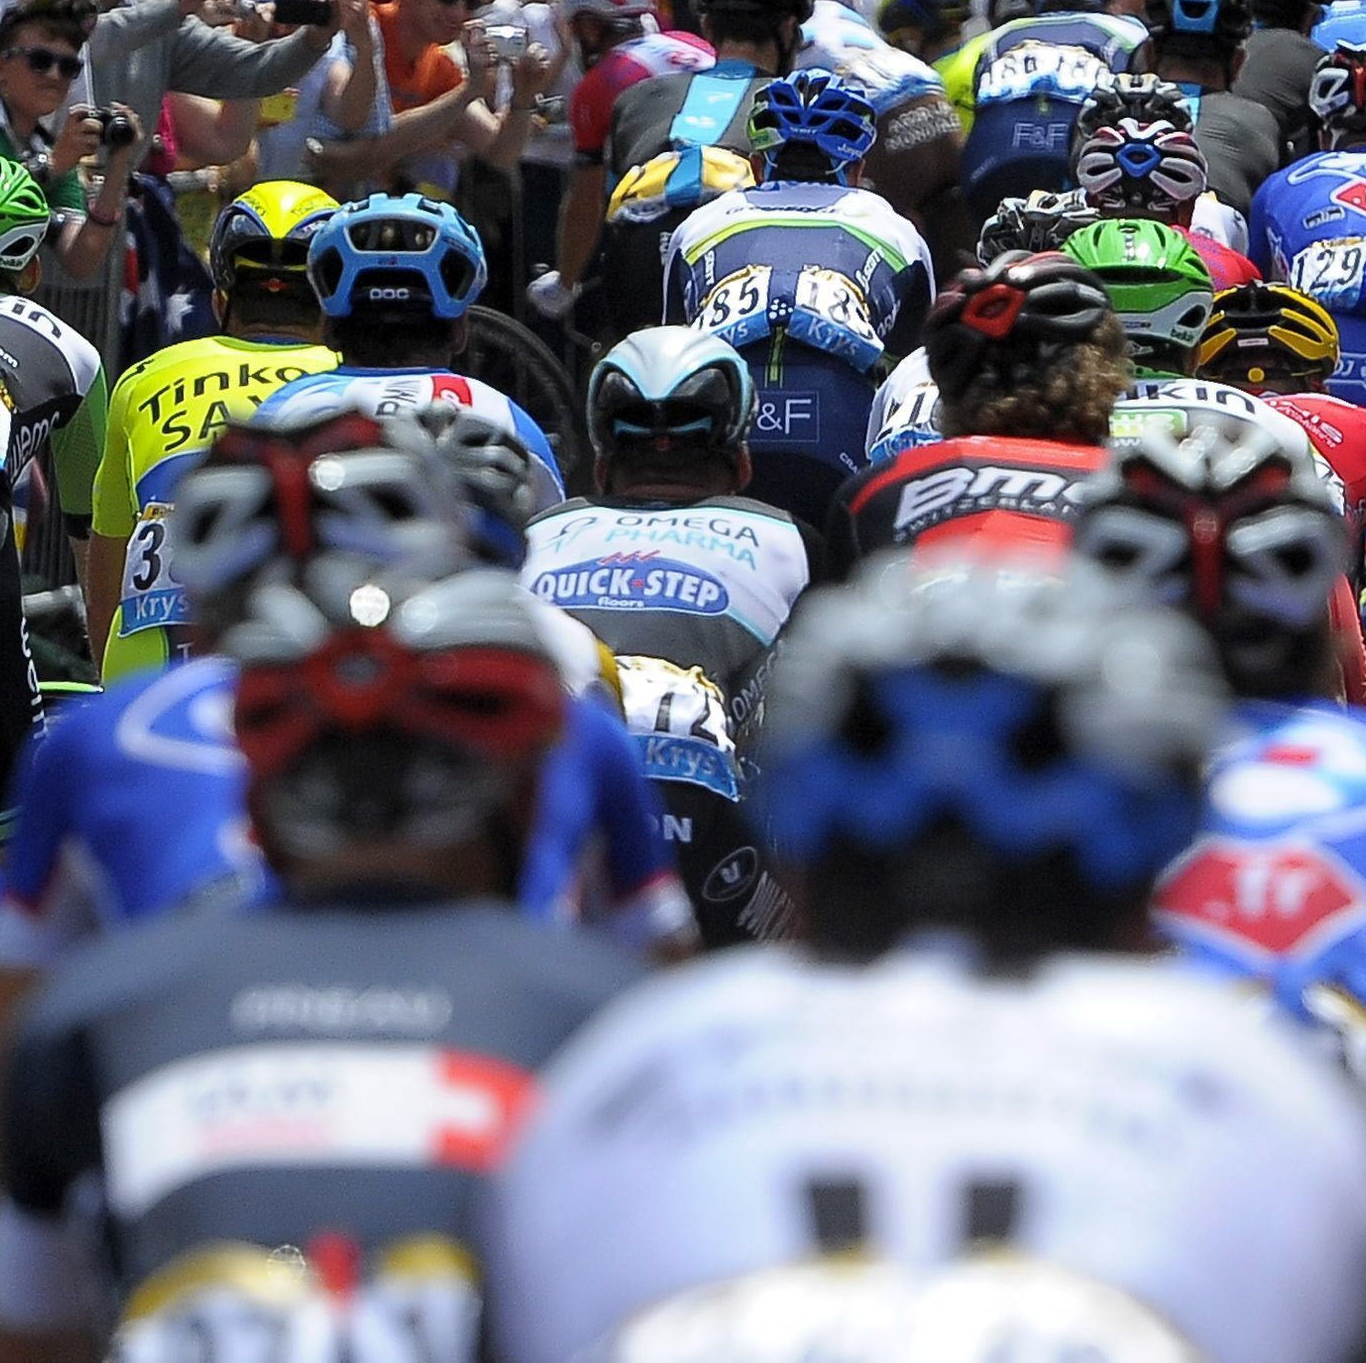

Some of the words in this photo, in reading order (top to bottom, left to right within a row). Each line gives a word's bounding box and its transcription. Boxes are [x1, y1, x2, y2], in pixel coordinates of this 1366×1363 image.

[1012, 122, 1069, 151] F&F
[1292, 246, 1362, 292] 129
[616, 516, 760, 548] OMEGA
[605, 529, 757, 571] PHARMA
[597, 597, 645, 608] floors
[645, 737, 717, 776] Krys
